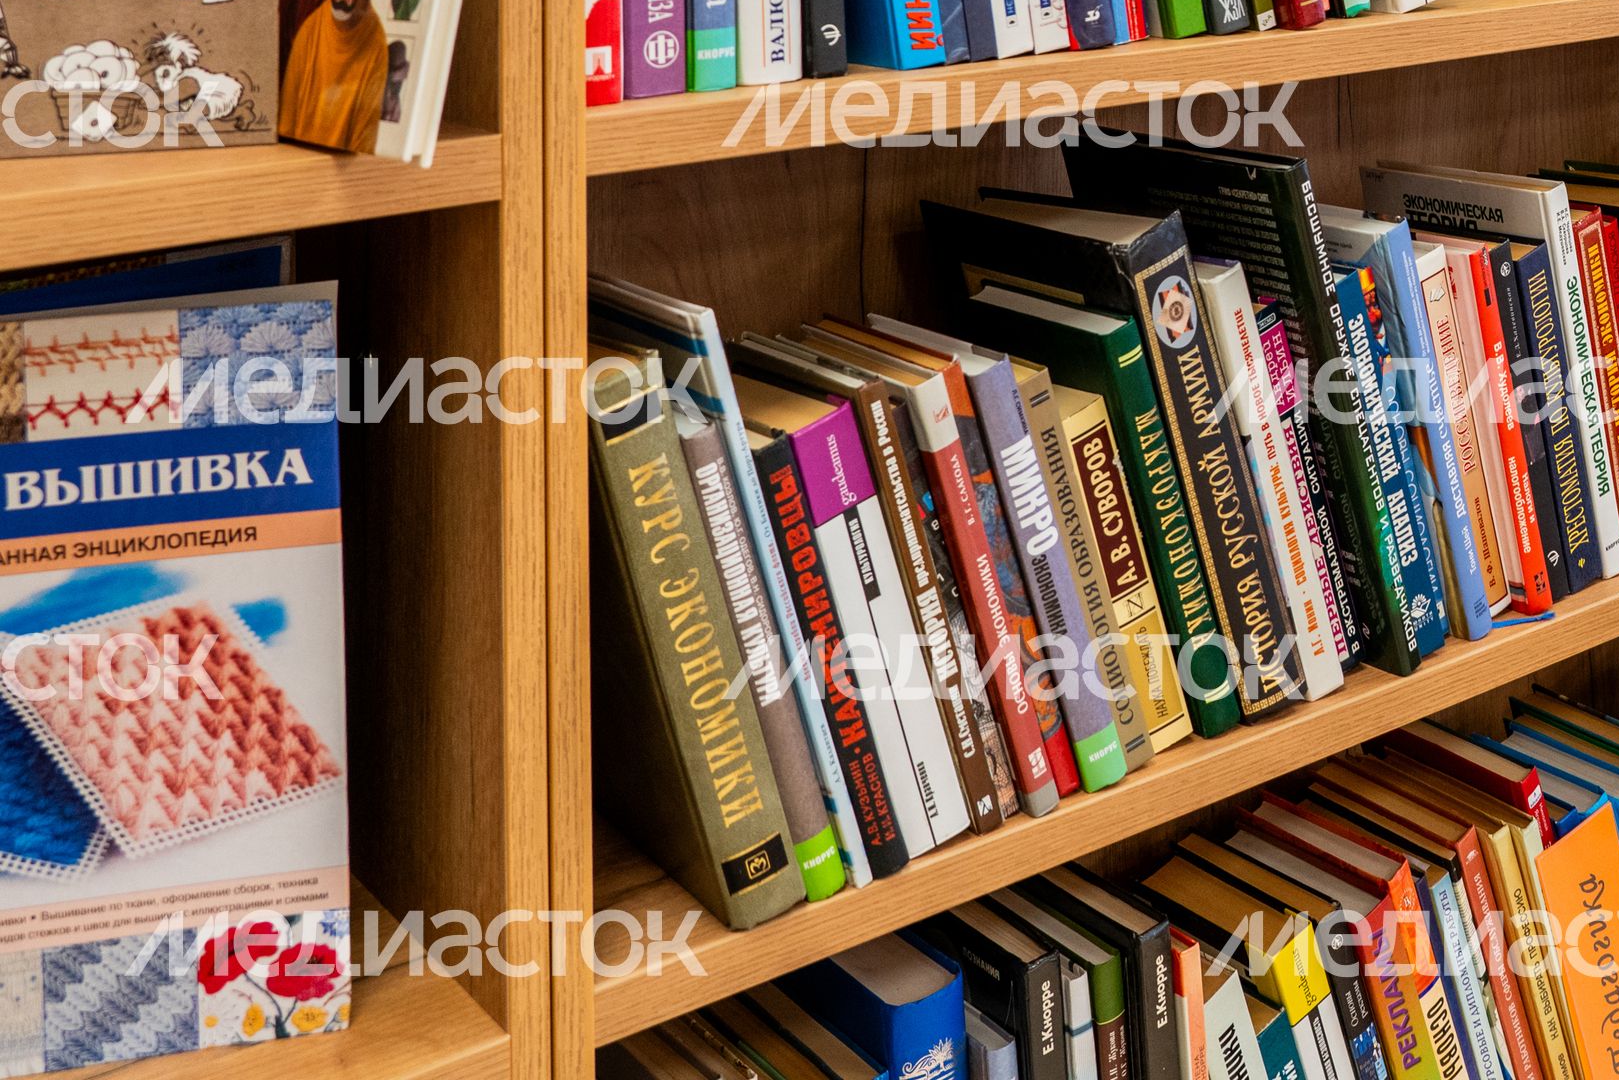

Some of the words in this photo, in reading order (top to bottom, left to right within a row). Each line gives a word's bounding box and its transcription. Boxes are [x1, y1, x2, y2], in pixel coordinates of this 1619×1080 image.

[1300, 179, 1336, 297] БЕСШУМНОЕ
[1177, 345, 1224, 437] АРМИИ
[1329, 302, 1356, 382] ОРУЖИЕ
[5, 448, 313, 511] ВЫШИВКА
[827, 435, 858, 506] gaudeamus
[1083, 437, 1127, 537] СУВОРОВ
[1345, 387, 1386, 512] СПЕЦАГЕНТОВ
[1346, 311, 1402, 483] ЭКОНОМИЧЕСКИЙ
[1386, 490, 1419, 567] АНАЛИЗ
[74, 526, 258, 558] ЭНЦИКЛОПЕДИЯ
[628, 453, 691, 565] КУРС
[1198, 441, 1258, 569] РУССКОЙ
[1379, 514, 1390, 528] И
[771, 465, 861, 748] КАНТЕМИРОВЦЫ
[1242, 570, 1286, 694] ИСТОРИЯ
[1382, 532, 1418, 652] РАЗВЕДЧИКОВ
[659, 566, 765, 829] ЭКОНОМИКИ
[41, 903, 107, 921] Вышивание
[162, 888, 232, 904] оформление
[277, 876, 319, 890] техника
